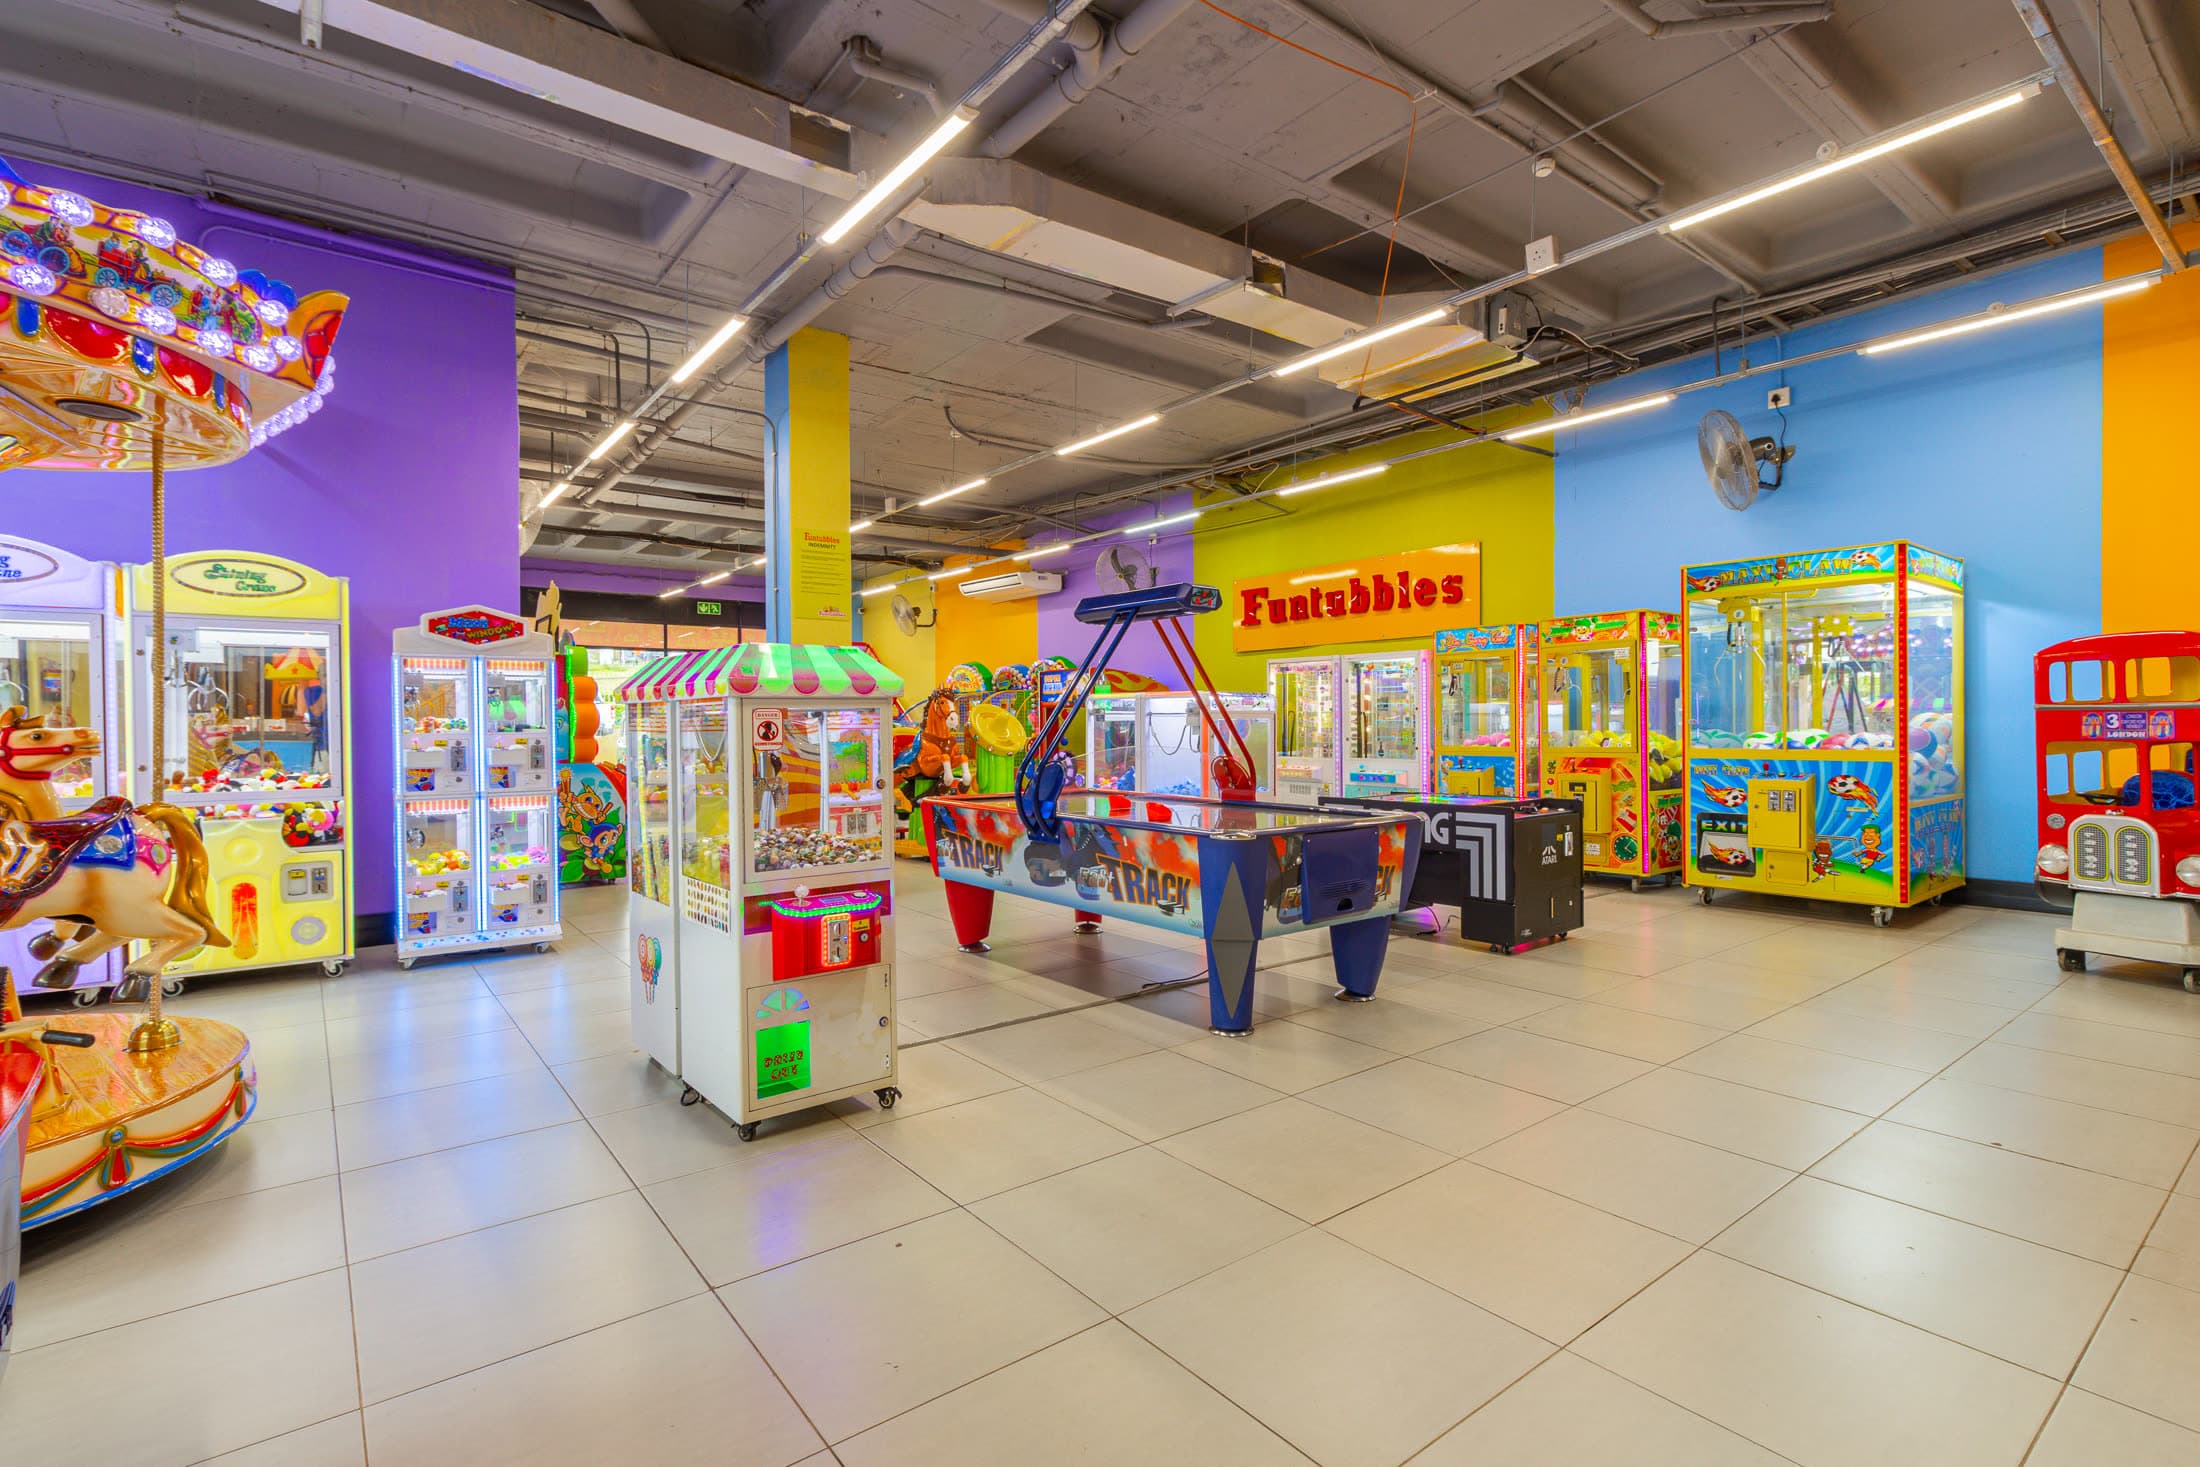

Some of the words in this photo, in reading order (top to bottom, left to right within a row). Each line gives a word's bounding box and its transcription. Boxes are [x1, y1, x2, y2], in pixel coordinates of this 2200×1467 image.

[1718, 564, 1773, 586] MAXI
[1787, 558, 1852, 579] CLAW
[1240, 570, 1464, 627] Funtubbles
[466, 623, 514, 640] WINDOW
[2106, 713, 2120, 729] 3
[1701, 820, 1748, 833] EXIT
[941, 828, 1004, 872] TRACK
[1541, 855, 1558, 865] ATARI
[1096, 853, 1191, 911] TRACK
